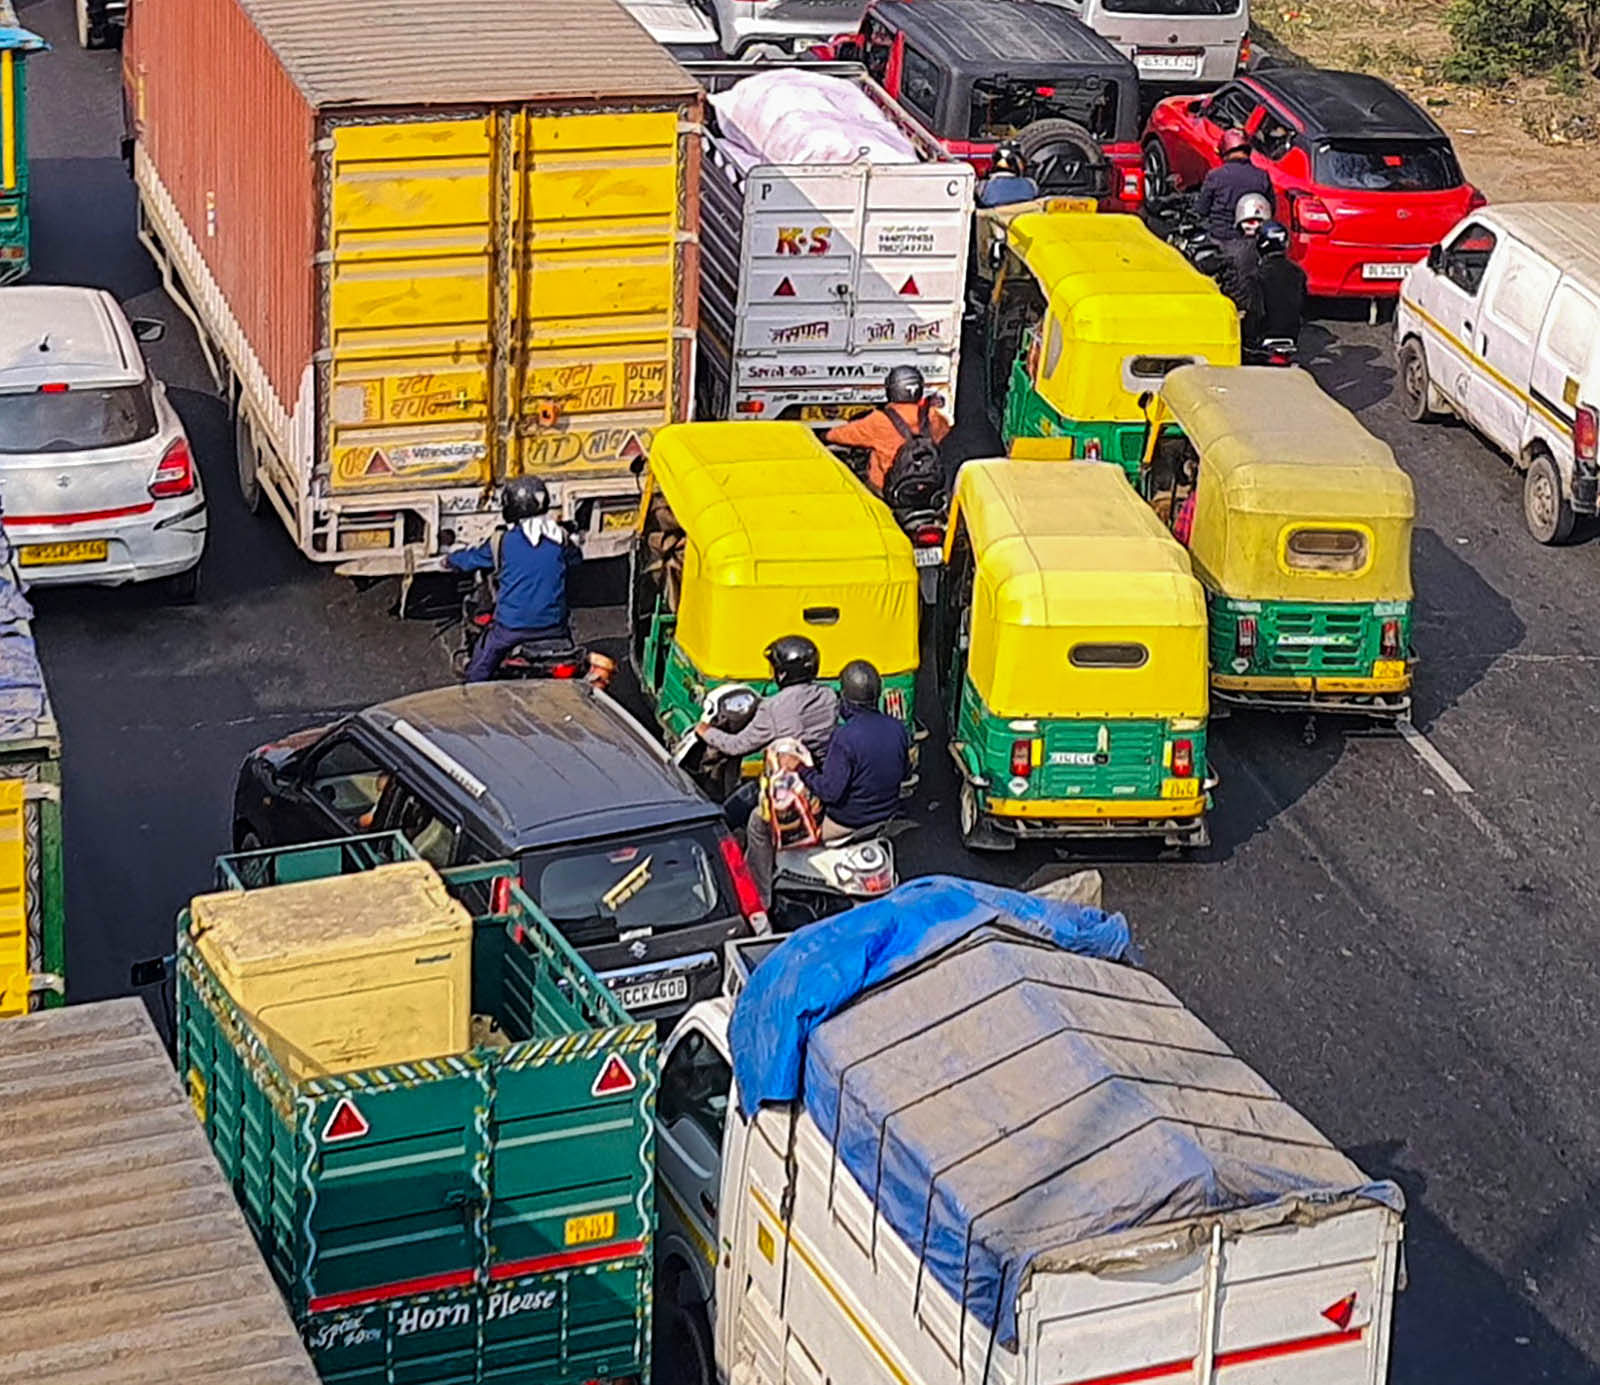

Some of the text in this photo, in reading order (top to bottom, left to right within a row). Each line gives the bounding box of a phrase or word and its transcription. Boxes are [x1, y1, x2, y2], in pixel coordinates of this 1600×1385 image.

[761, 183, 772, 200] P
[946, 180, 959, 196] C
[826, 366, 866, 377] TATA
[398, 1303, 470, 1335] Horn
[485, 1289, 558, 1320] Please
